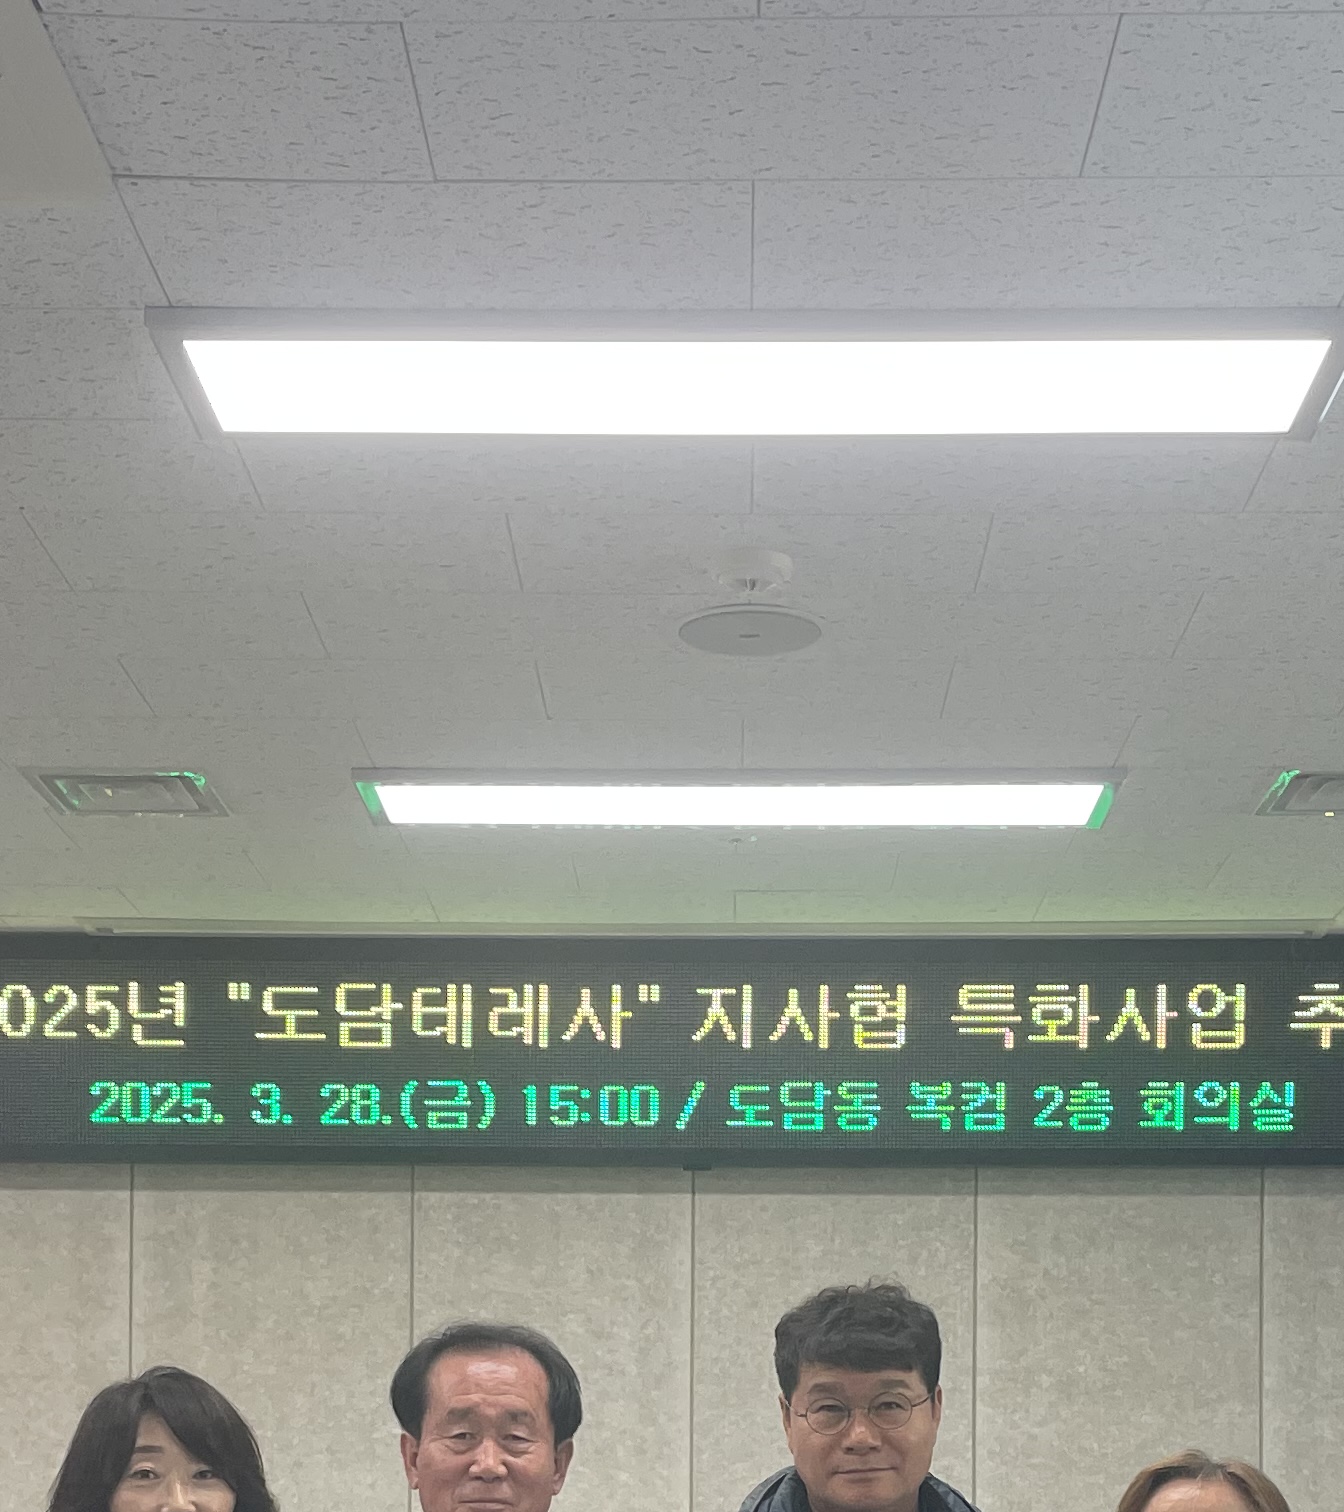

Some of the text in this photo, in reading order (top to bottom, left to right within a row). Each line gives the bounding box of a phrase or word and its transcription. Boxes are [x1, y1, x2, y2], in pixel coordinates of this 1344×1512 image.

[227, 982, 660, 1050] "도담테레사"
[691, 983, 906, 1051] 지사협
[950, 983, 1246, 1050] 특화사업
[88, 1080, 225, 1126] 2025.
[249, 1081, 294, 1126] 3.
[522, 1081, 661, 1128] 15:00
[675, 1080, 706, 1131] /
[725, 1080, 880, 1132] 도담동
[906, 1080, 1008, 1132] 복컴
[1033, 1081, 1114, 1132] 2층
[1137, 1080, 1297, 1133] 회의실
